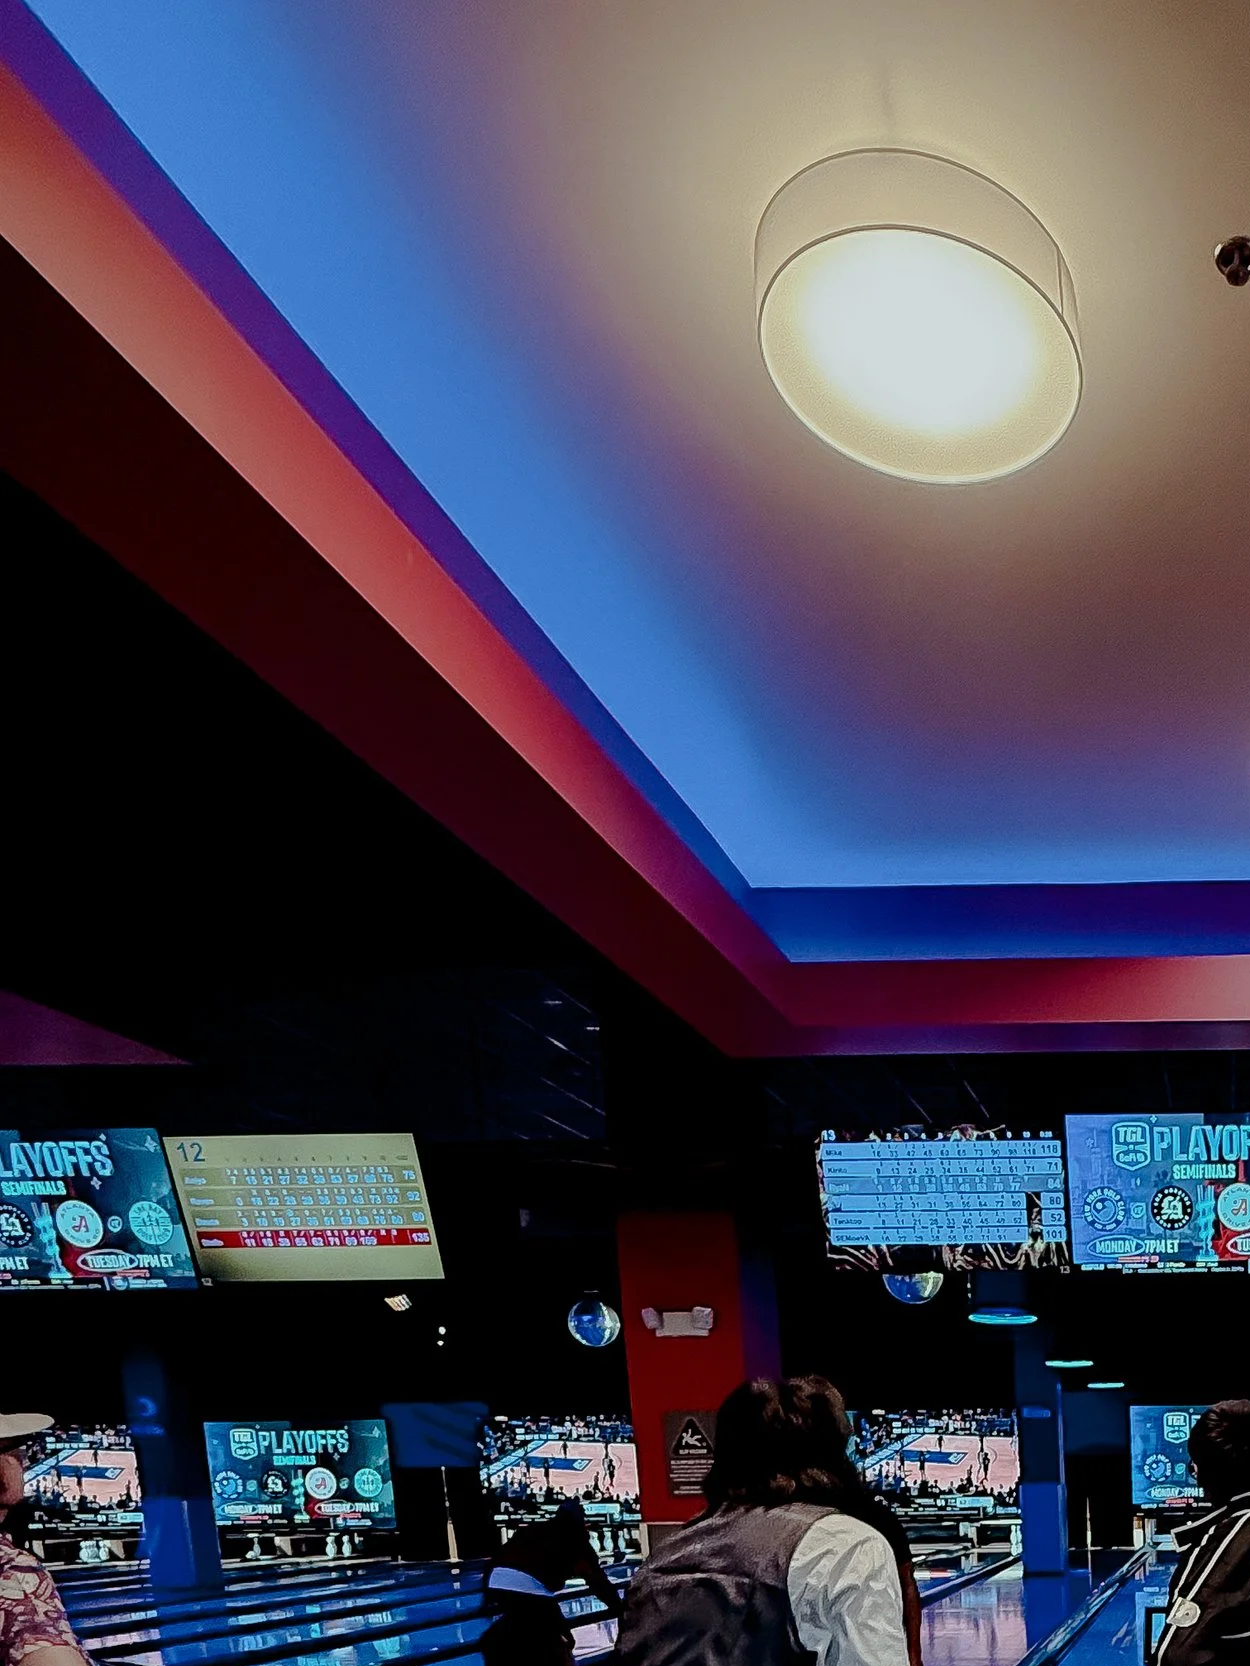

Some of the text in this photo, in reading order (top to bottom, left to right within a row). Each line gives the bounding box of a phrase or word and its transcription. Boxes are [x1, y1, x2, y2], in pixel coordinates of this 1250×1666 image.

[822, 1130, 836, 1141] 13
[1117, 1127, 1144, 1143] TGL
[177, 1142, 205, 1162] 12
[1041, 1144, 1058, 1153] 118
[1047, 1162, 1058, 1171] 71
[1173, 1164, 1236, 1179] SEMIFINALS
[2, 1181, 66, 1195] SEMIFINALS
[1051, 1213, 1062, 1222] 52
[1096, 1240, 1179, 1253] MONDAY 7PM ET
[87, 1255, 132, 1268] TUESDAY
[258, 1430, 349, 1454] PLAYOFFS
